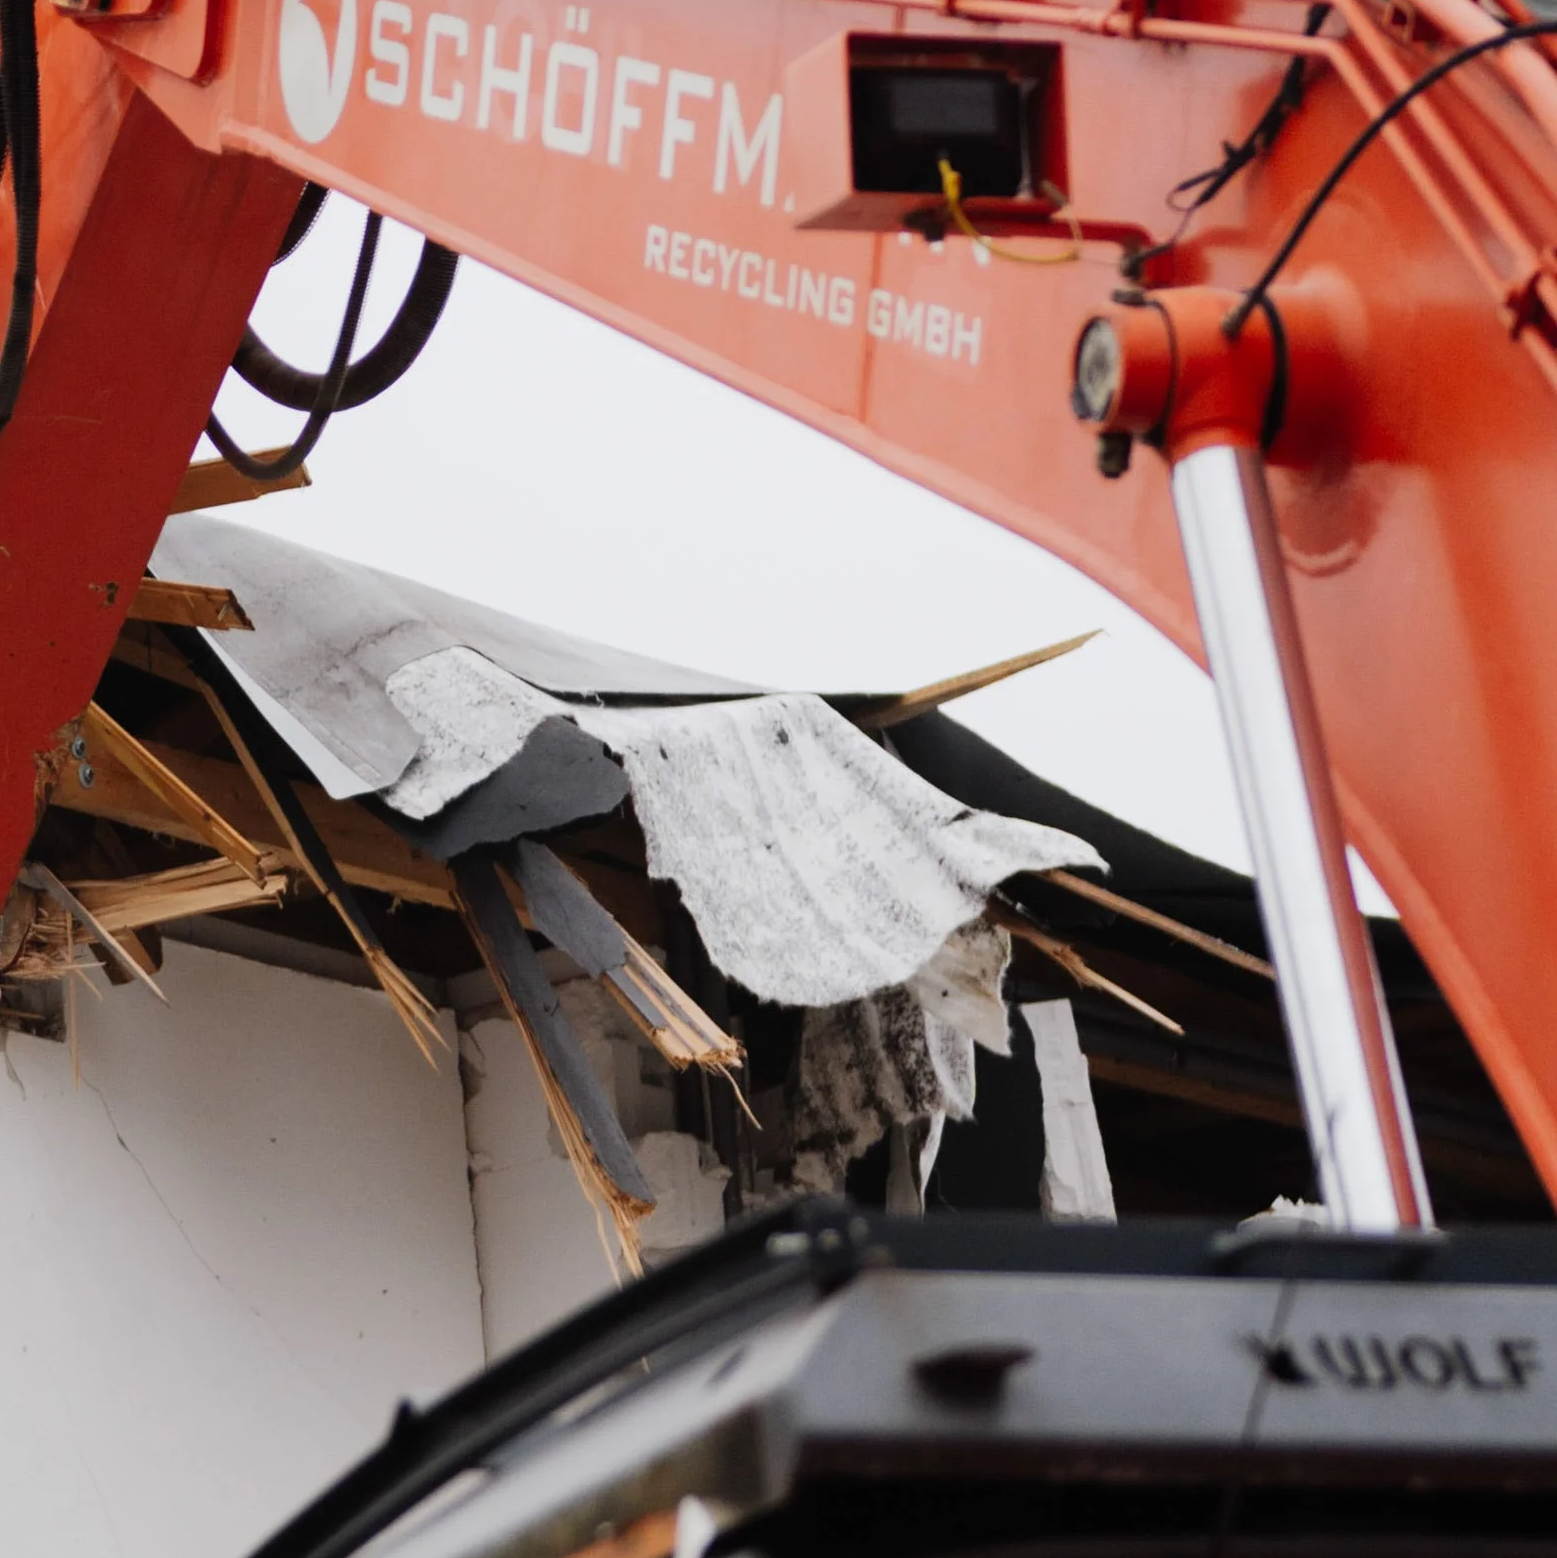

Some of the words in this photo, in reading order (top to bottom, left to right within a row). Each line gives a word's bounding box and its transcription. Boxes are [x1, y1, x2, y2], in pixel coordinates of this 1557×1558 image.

[365, 0, 991, 266] SCHÖFFM
[644, 225, 855, 325] RECYCLING
[867, 290, 982, 365] GMBH
[1312, 1333, 1542, 1390] WOLF
